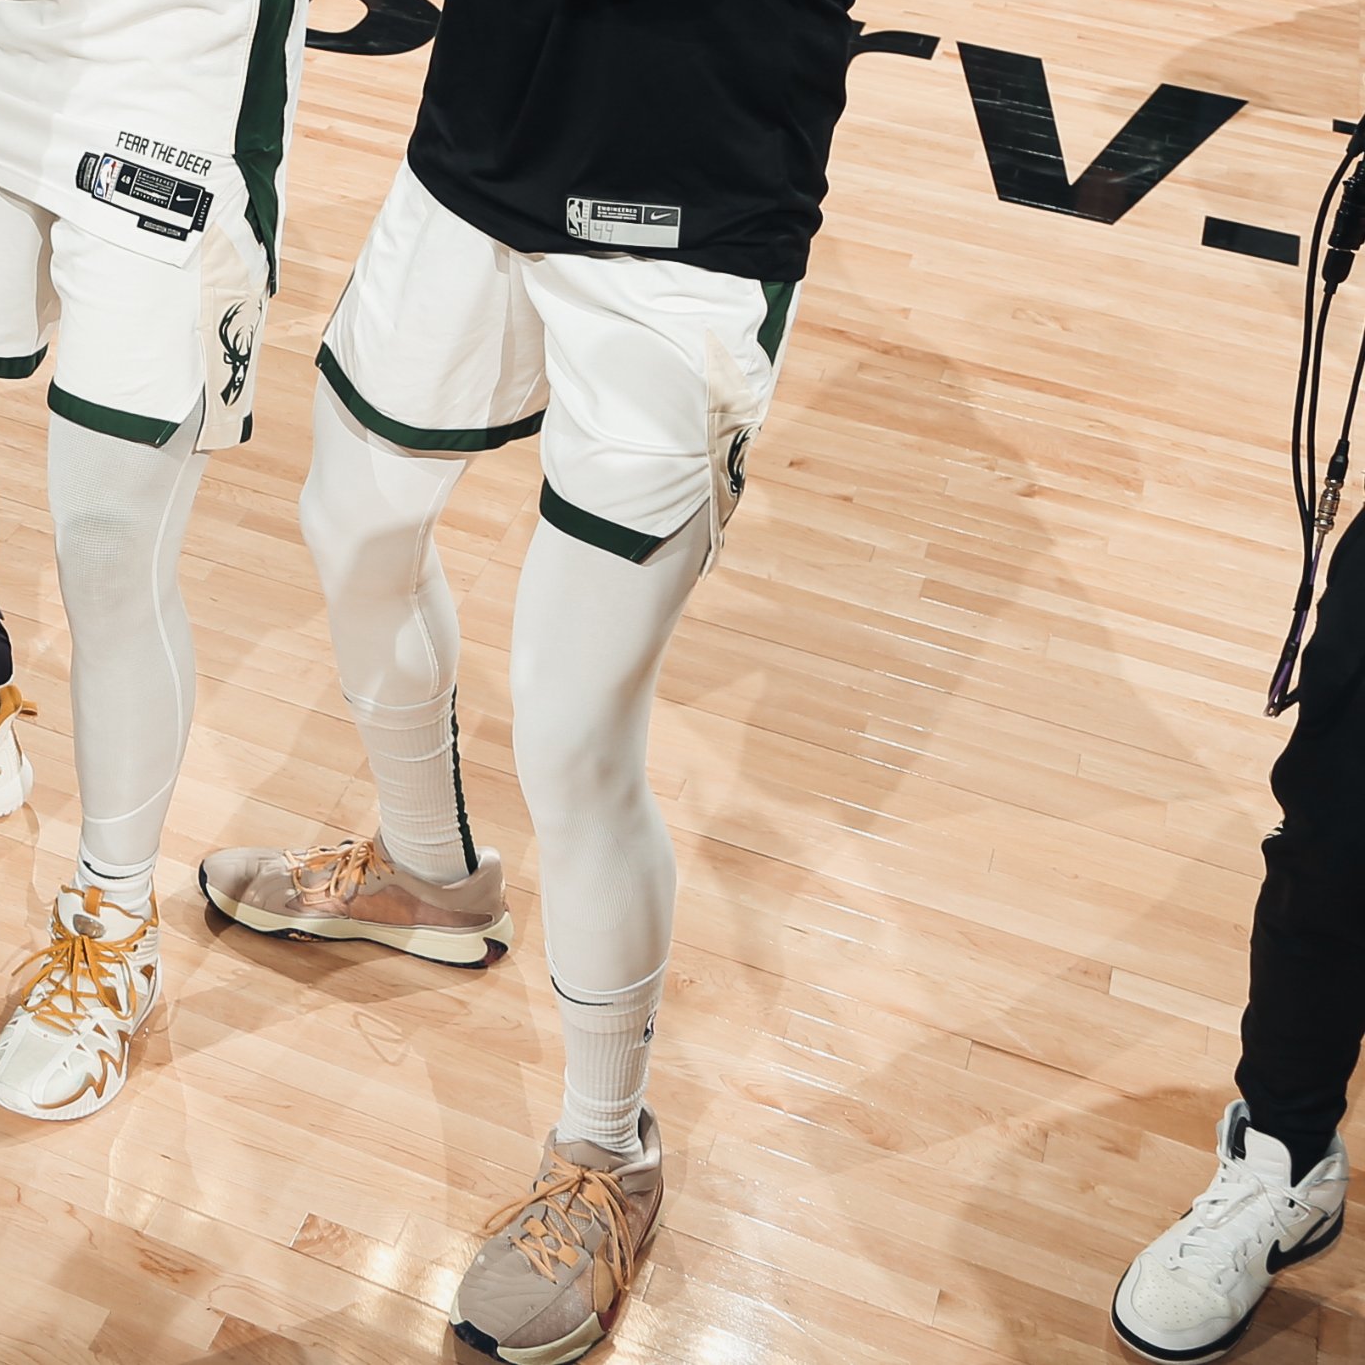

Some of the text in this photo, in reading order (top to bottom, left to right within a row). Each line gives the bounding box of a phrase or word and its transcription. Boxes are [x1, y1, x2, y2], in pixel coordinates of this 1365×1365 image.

[115, 130, 212, 177] FEAR THE DEER
[596, 204, 639, 215] ENGINEERED
